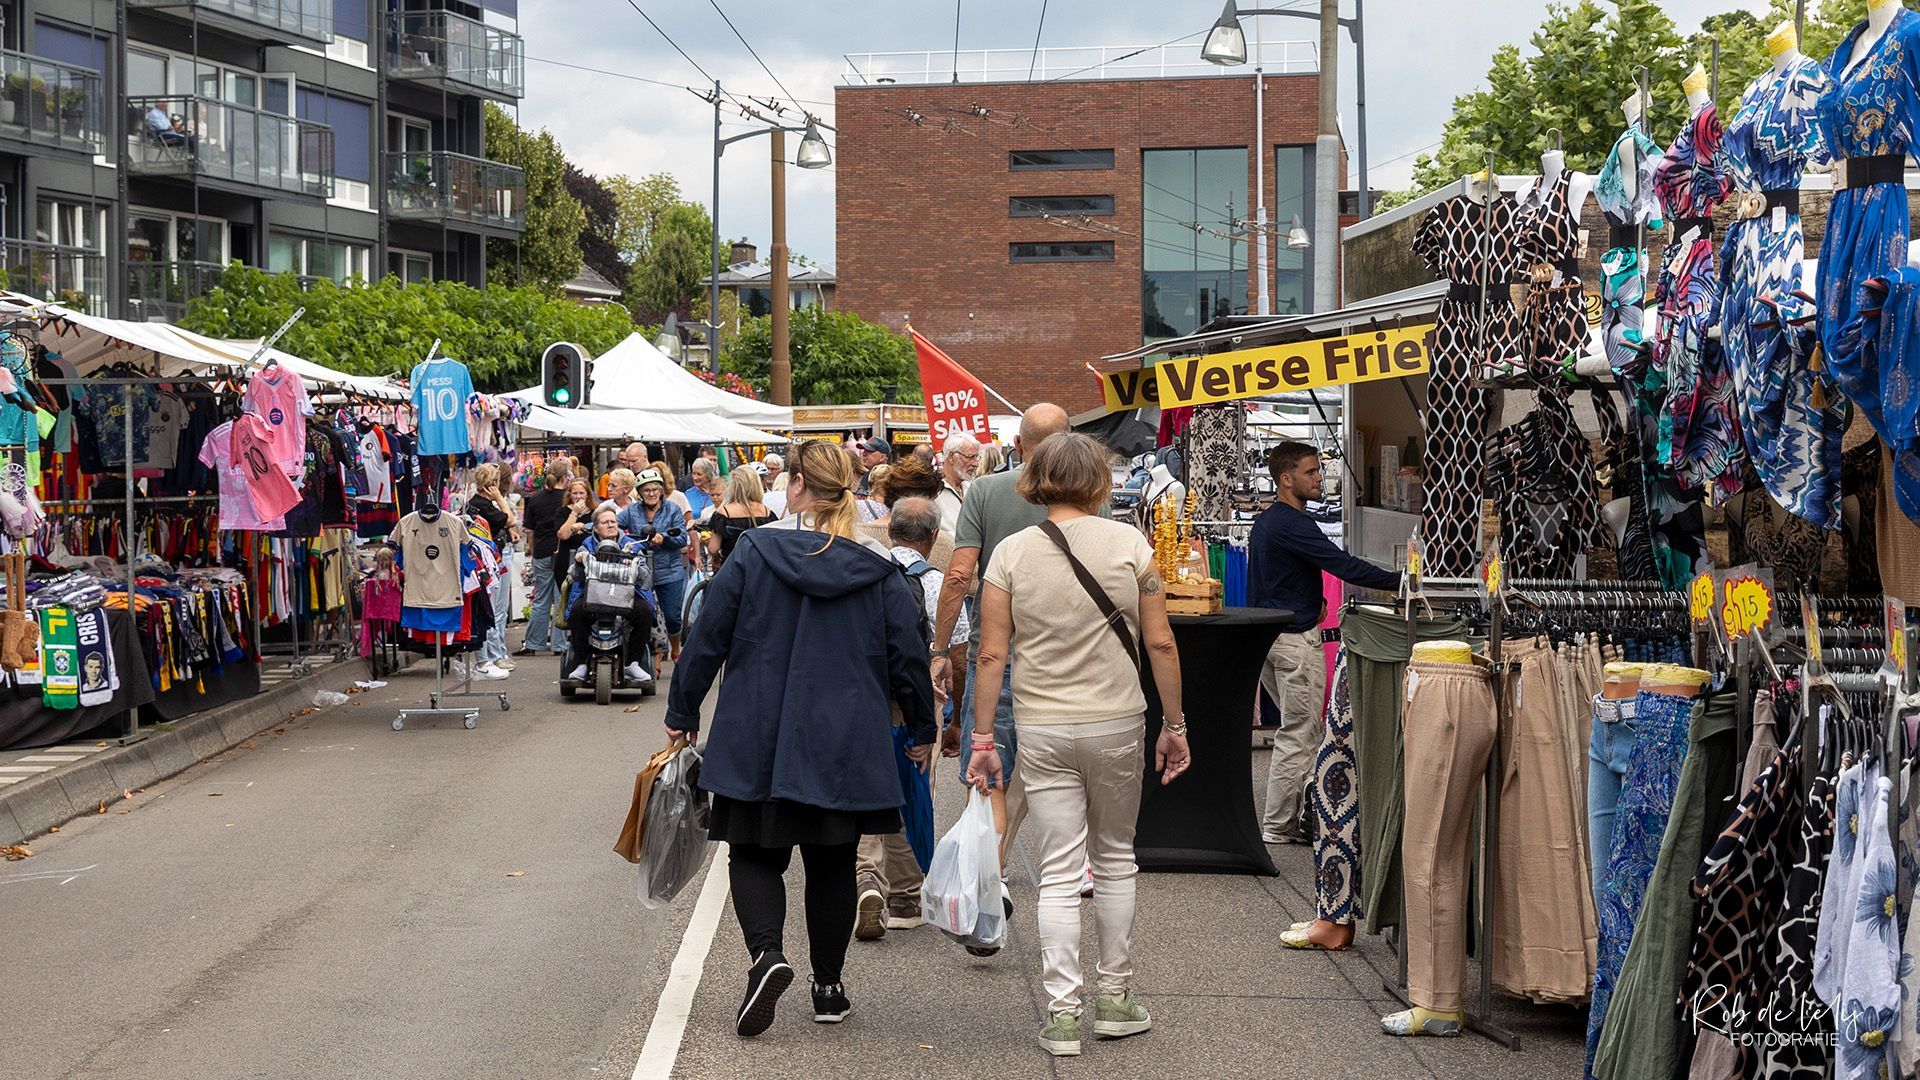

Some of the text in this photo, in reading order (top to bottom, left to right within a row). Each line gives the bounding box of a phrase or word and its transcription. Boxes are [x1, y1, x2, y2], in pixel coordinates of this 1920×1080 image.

[427, 377, 453, 386] MESSI
[1163, 358, 1311, 401] Verse
[422, 388, 458, 421] 10
[932, 388, 978, 413] 50%
[897, 434, 928, 442] Spaanse
[933, 413, 986, 440] SALE
[244, 446, 269, 482] 10
[1698, 585, 1707, 609] 15
[1742, 595, 1758, 617] 15
